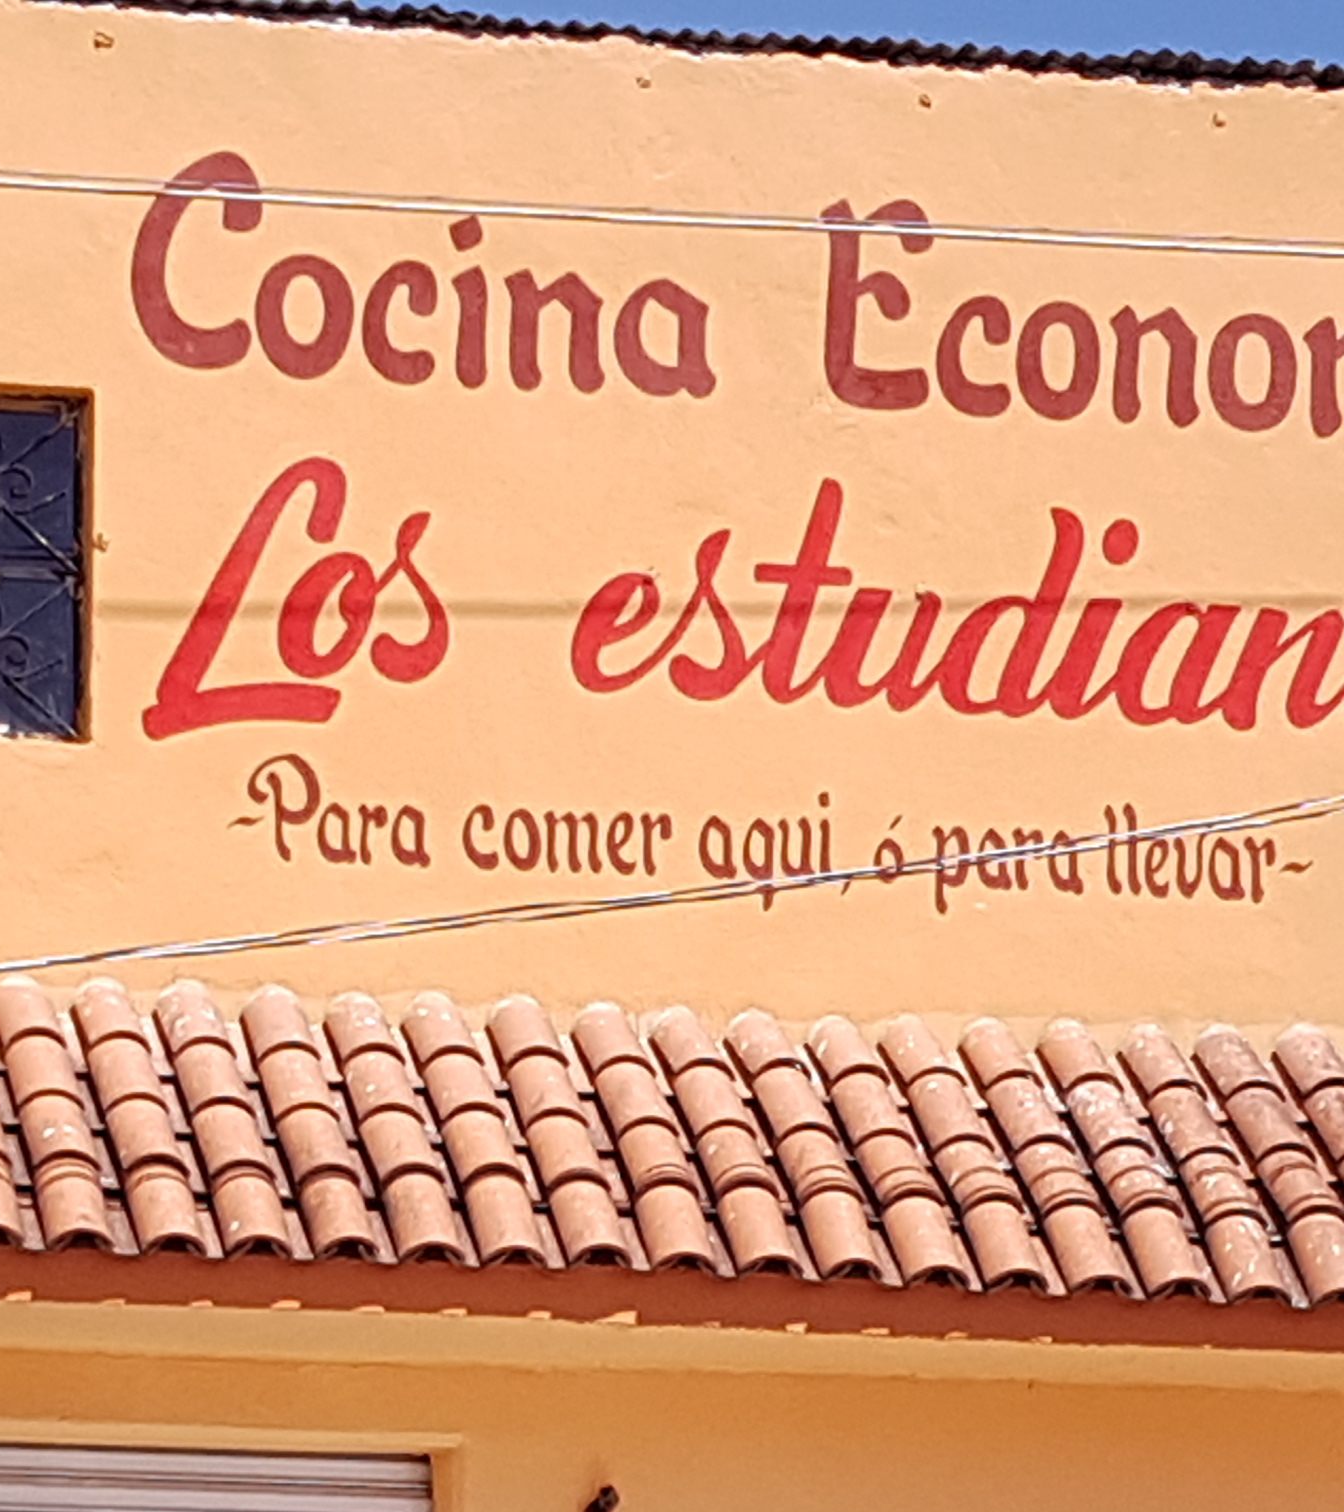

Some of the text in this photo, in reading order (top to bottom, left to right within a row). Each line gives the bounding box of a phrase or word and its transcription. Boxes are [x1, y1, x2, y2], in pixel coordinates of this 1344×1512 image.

[130, 151, 718, 398] Cocina
[141, 456, 449, 741] Los
[462, 803, 673, 877] comer
[931, 823, 1084, 914] para
